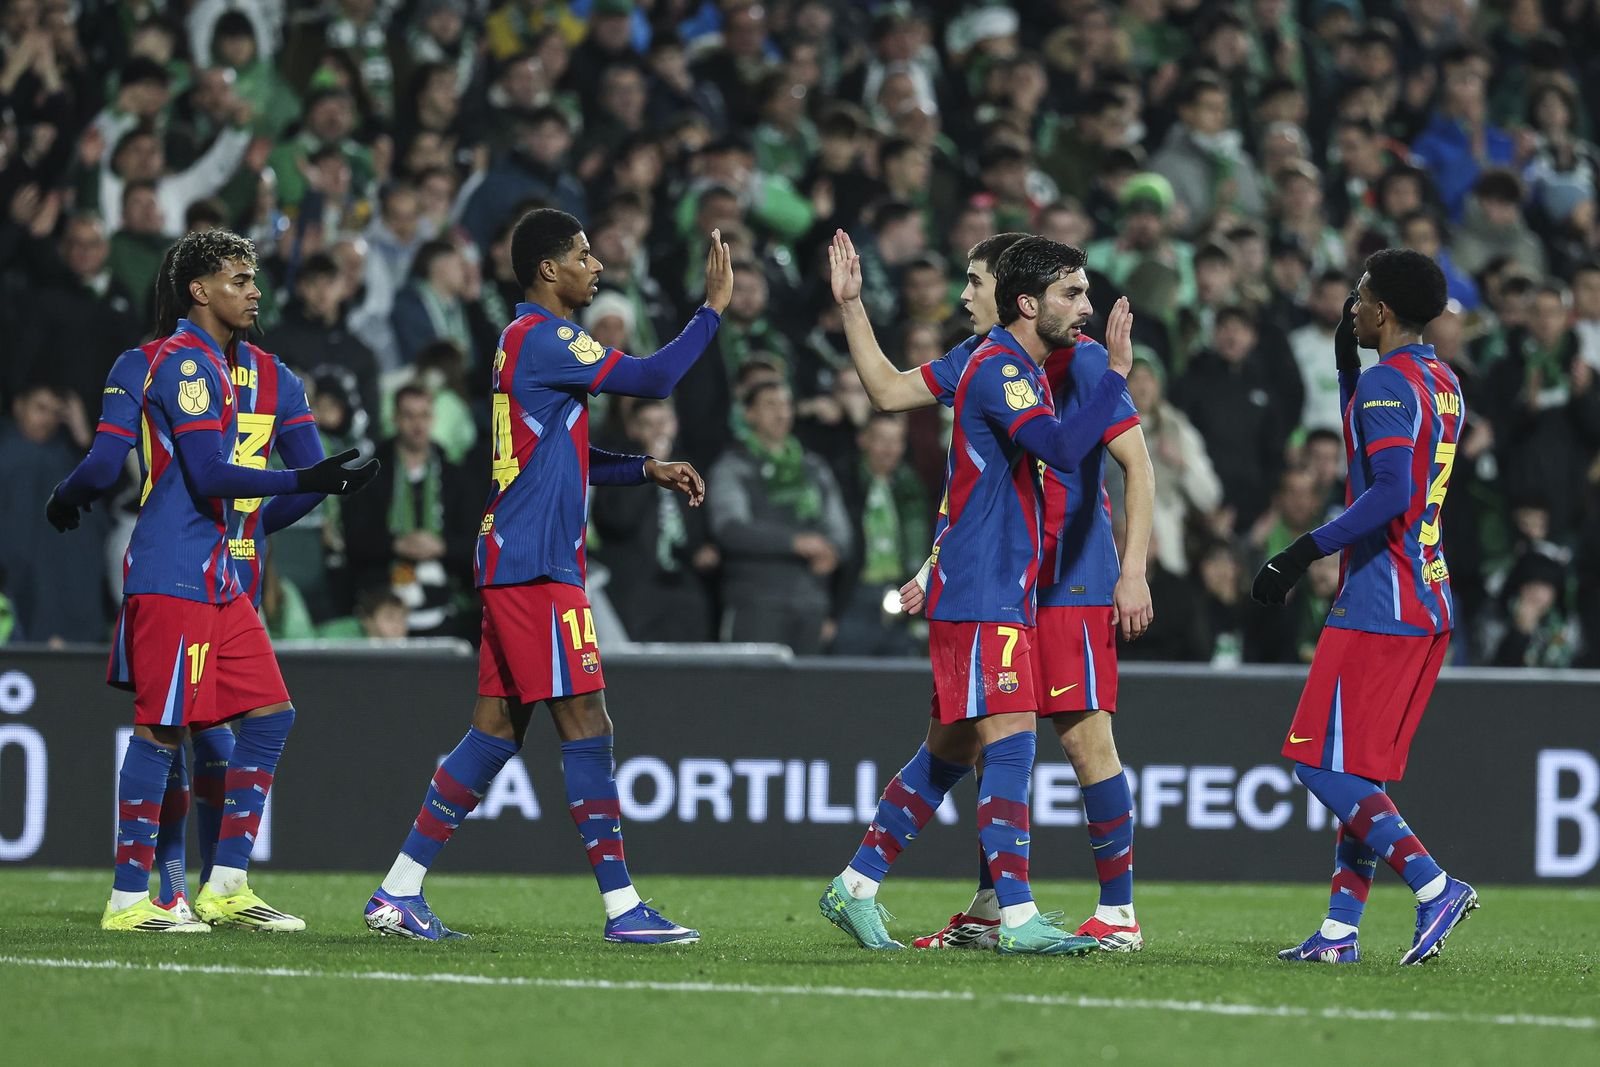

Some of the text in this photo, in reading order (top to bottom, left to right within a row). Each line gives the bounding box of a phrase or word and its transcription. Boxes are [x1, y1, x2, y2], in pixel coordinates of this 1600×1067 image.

[1363, 400, 1401, 409] AMBILIGHT
[492, 393, 520, 492] 4
[1419, 442, 1456, 546] 3
[228, 538, 255, 548] NHCR
[229, 547, 256, 557] CNUR
[562, 608, 599, 650] 14
[996, 625, 1019, 667] 7
[562, 757, 959, 826] ORTILL
[1029, 761, 1339, 831] EFEC
